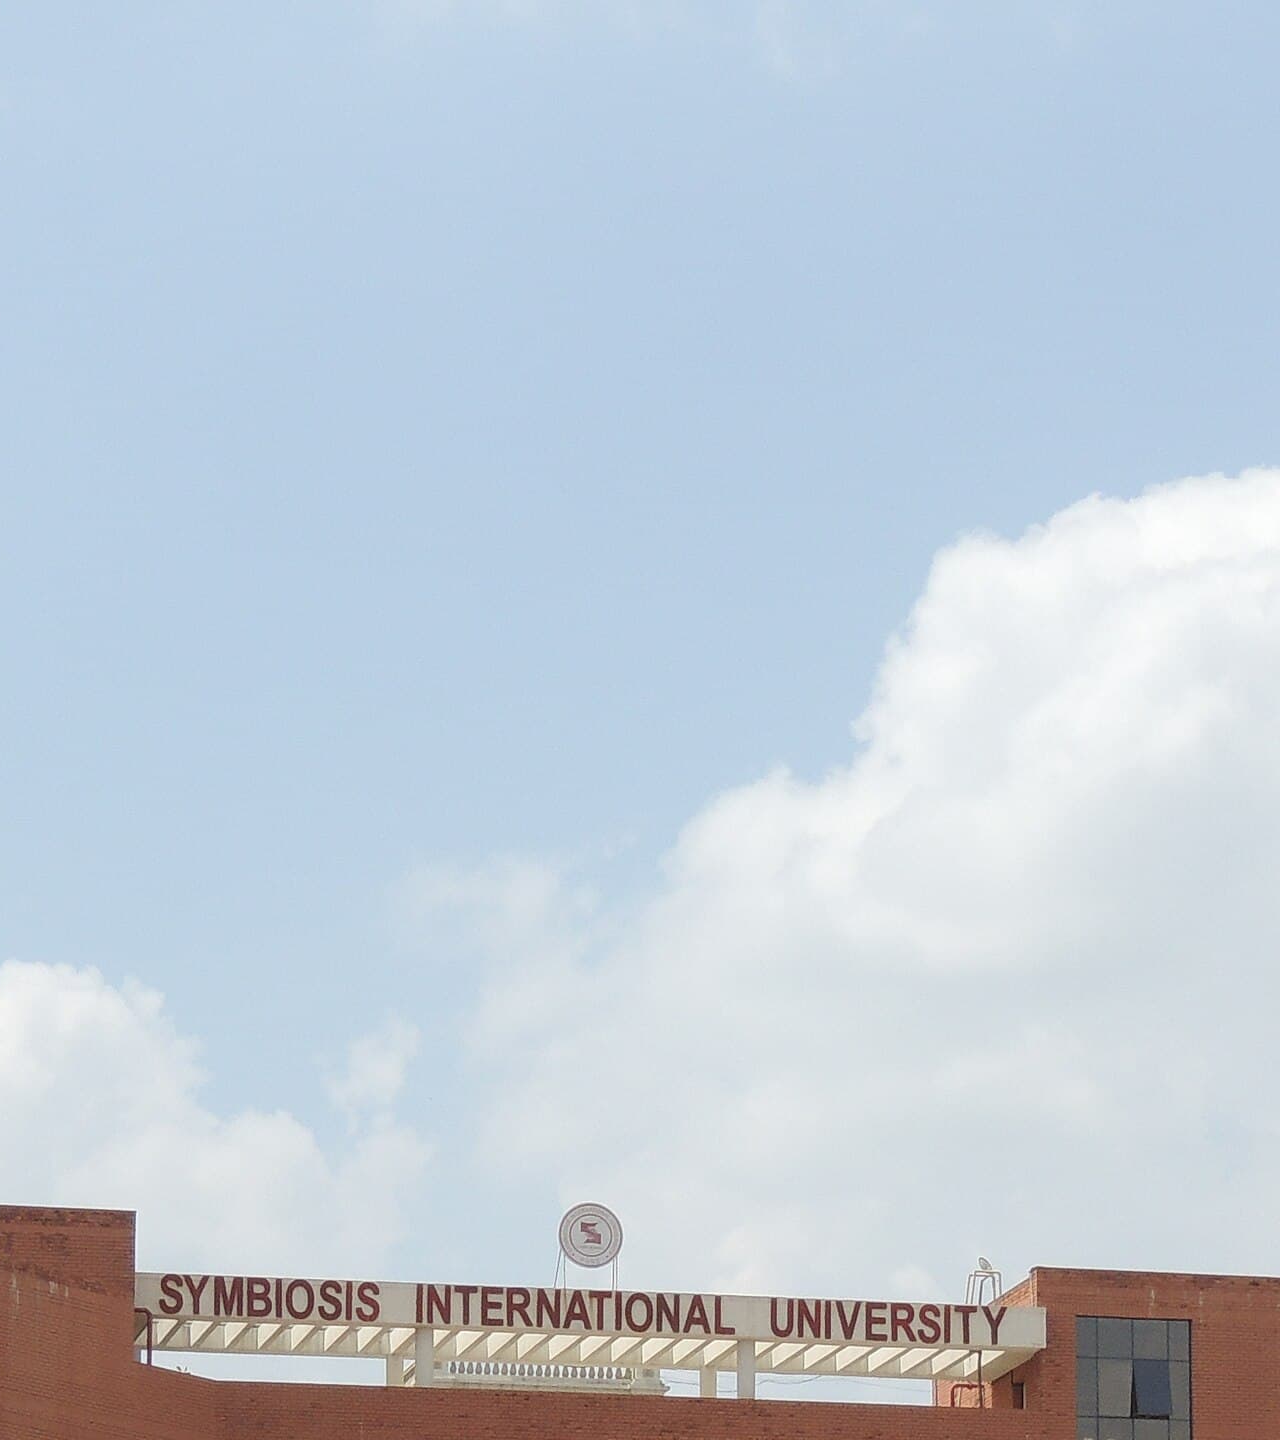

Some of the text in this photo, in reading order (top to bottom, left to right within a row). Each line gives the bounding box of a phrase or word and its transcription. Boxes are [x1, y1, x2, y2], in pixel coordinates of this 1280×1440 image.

[158, 1273, 1008, 1346] SYMBIOSIS INTERNATIONAL UNIVERSITY
